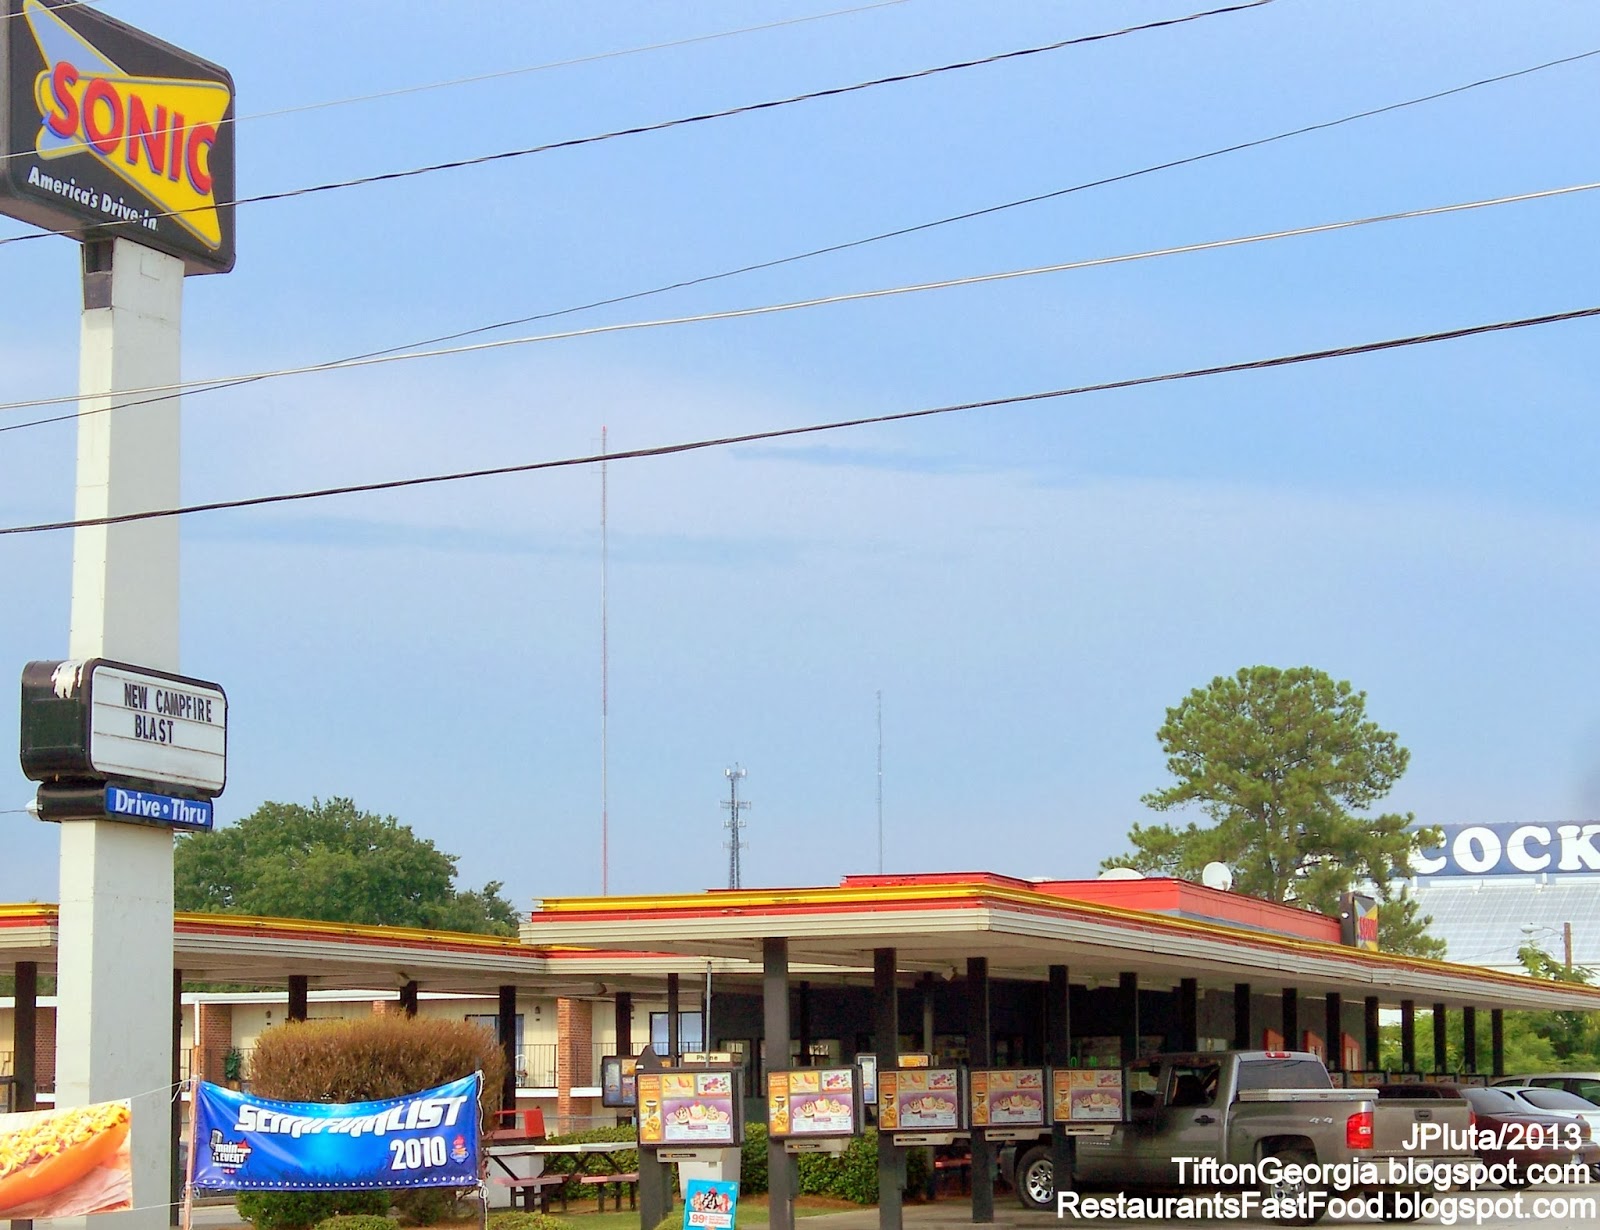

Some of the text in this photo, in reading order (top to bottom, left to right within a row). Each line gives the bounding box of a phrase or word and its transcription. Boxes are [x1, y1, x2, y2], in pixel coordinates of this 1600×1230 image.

[42, 61, 216, 195] SONIC
[28, 165, 99, 209] America's
[124, 683, 212, 722] NEW CAMPFIRE
[135, 714, 174, 743] BLAST
[390, 1136, 447, 1170] 2010
